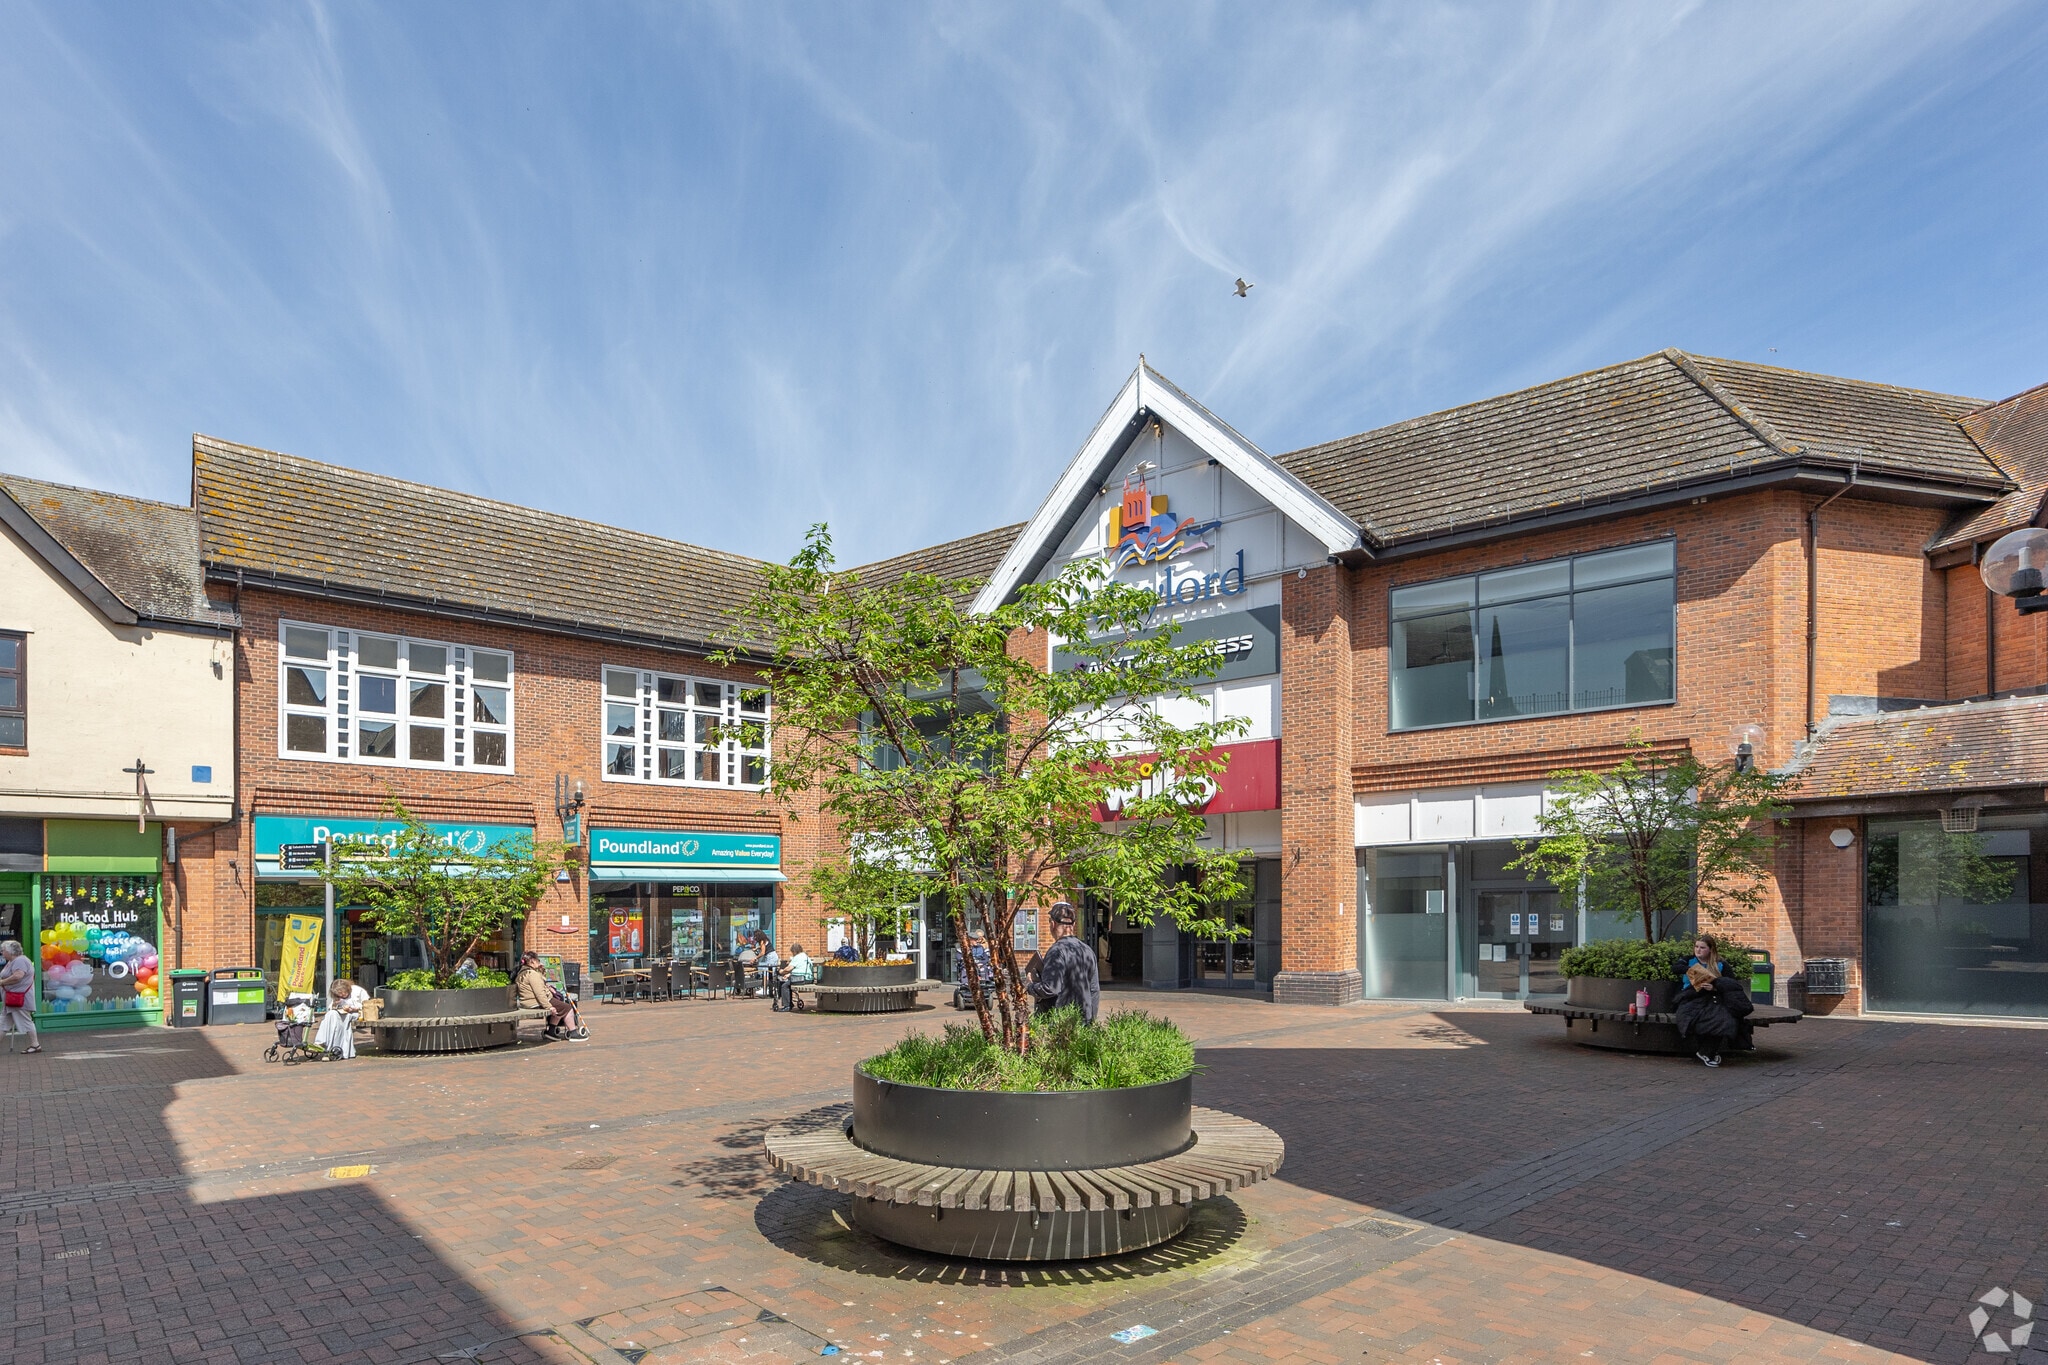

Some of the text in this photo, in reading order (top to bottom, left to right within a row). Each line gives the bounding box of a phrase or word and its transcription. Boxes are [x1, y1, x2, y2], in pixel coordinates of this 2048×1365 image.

[1077, 549, 1248, 625] ylord
[313, 826, 453, 849] Poundad
[599, 838, 680, 855] Poundland
[711, 849, 774, 858] Amazing Value Everyday!
[60, 910, 138, 923] Hot Food Hub
[292, 946, 305, 987] Poundland
